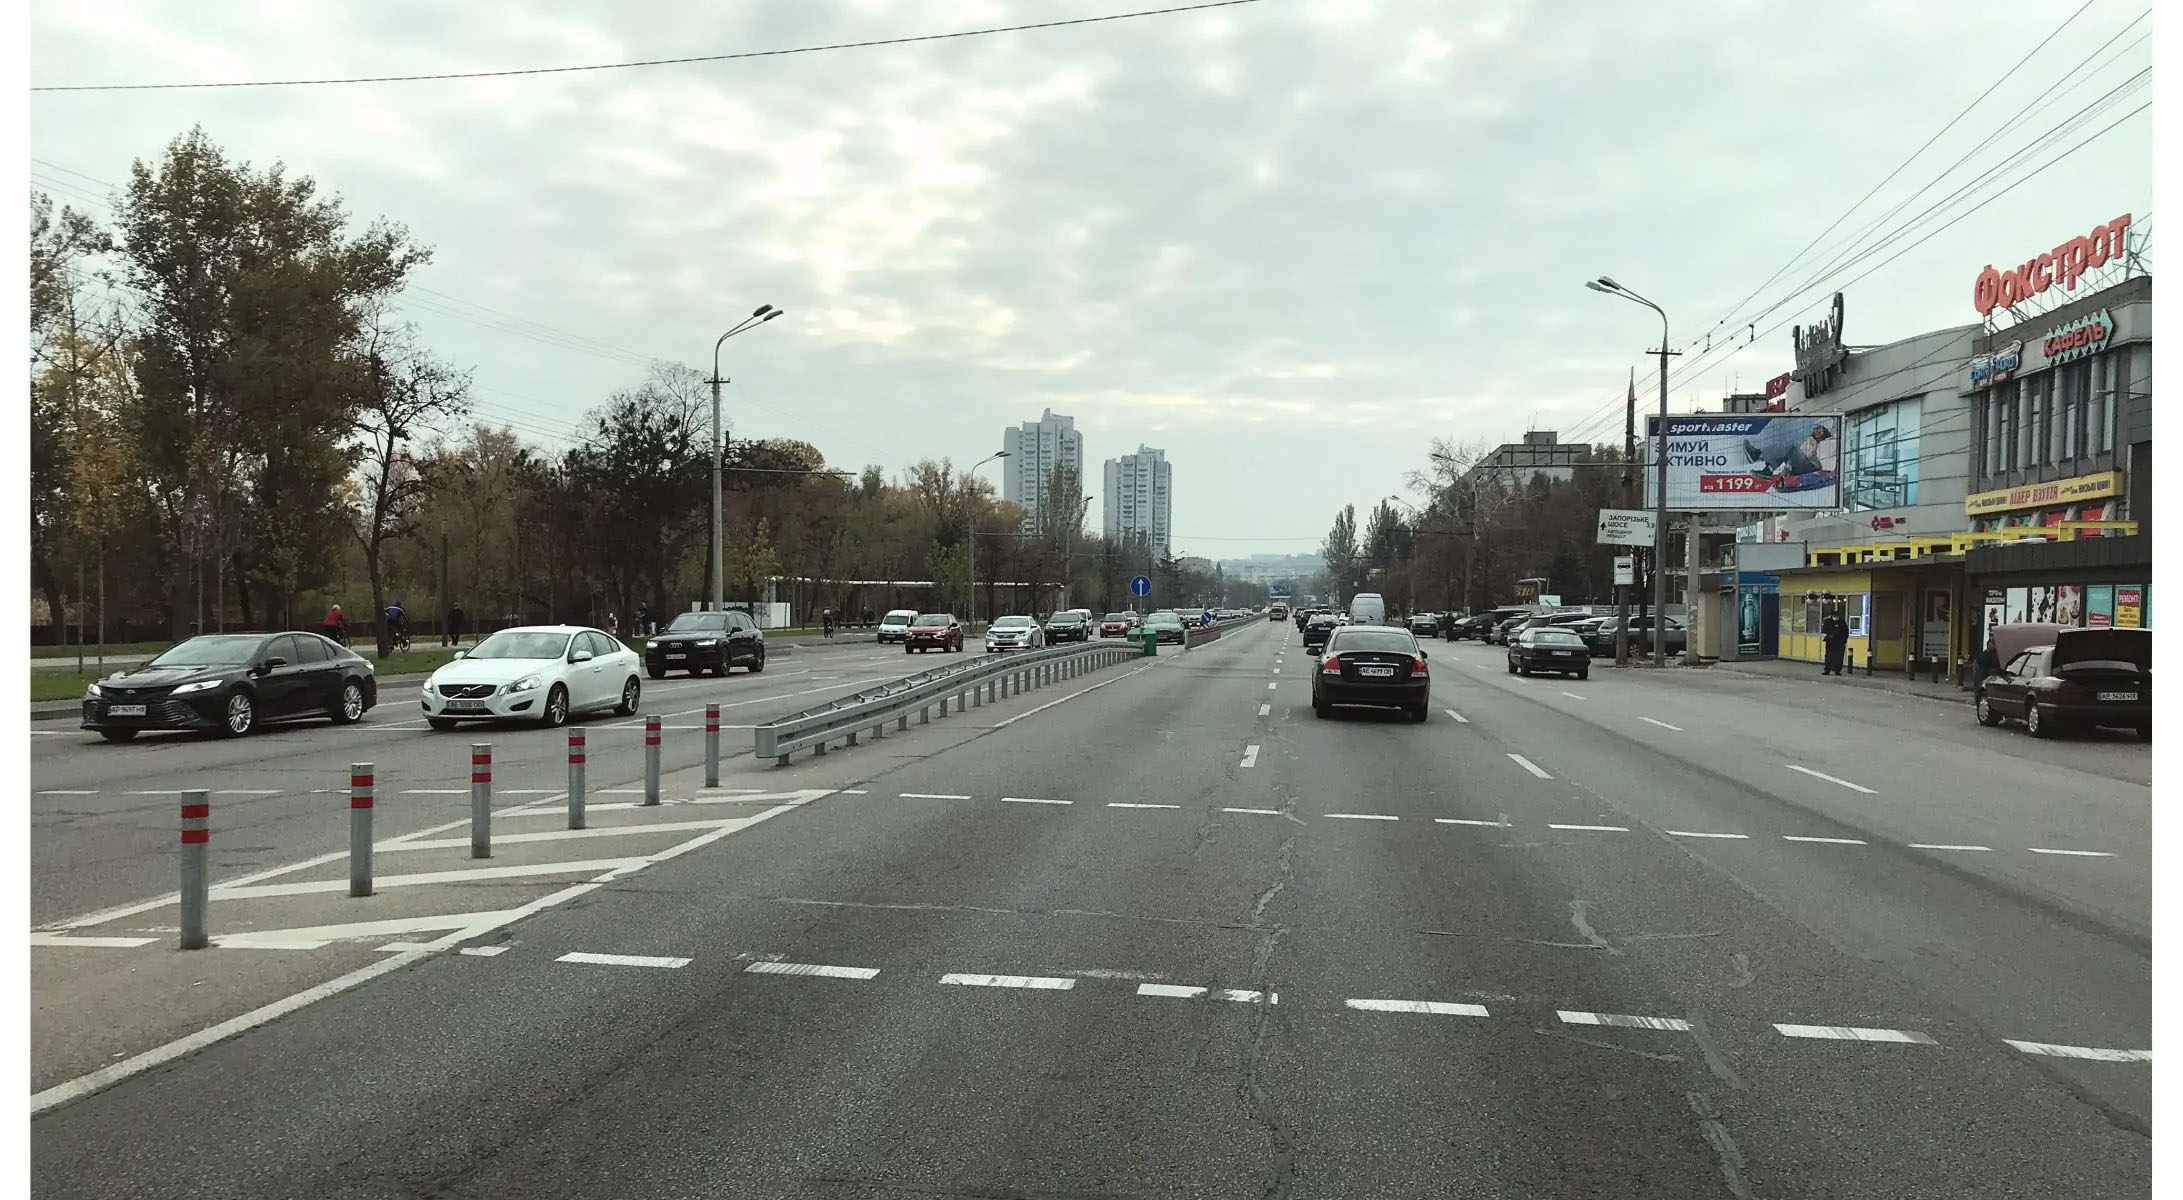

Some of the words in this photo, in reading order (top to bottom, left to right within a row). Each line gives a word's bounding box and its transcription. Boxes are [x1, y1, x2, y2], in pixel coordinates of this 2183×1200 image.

[2042, 322, 2106, 358] КАФЕЛЬ
[1658, 455, 1728, 467] КТИВНО
[2009, 490, 2030, 504] ЛІДЕР
[2032, 485, 2059, 502] ВЗУТТЯ
[1608, 514, 1649, 523] ЗАПОРІЗЬКЕ
